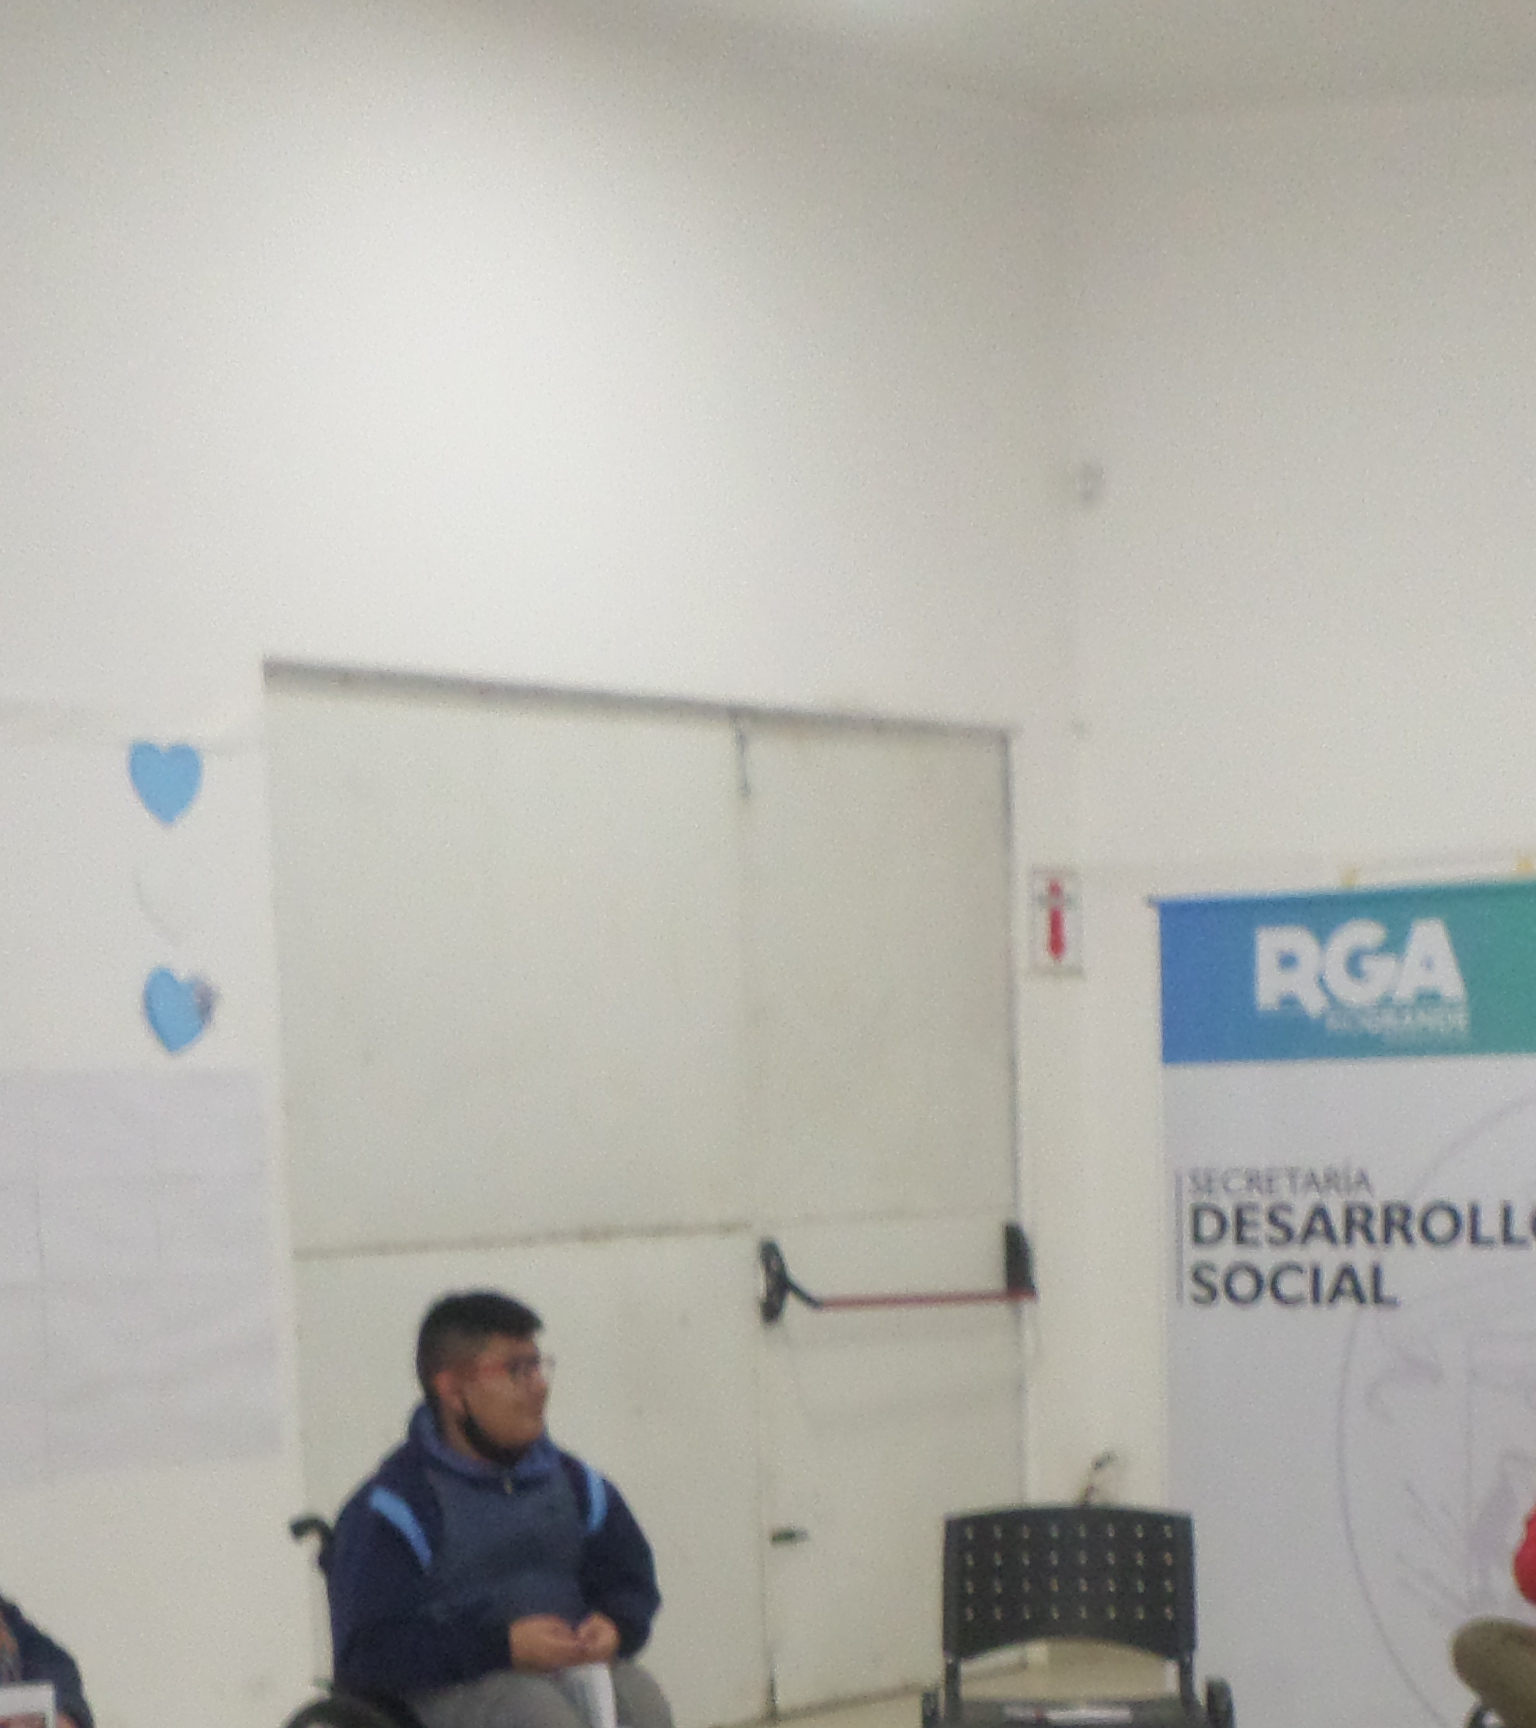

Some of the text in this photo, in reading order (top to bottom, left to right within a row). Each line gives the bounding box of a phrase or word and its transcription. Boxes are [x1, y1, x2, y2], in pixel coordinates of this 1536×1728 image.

[1254, 917, 1466, 1018] RGA
[1188, 1157, 1374, 1198] SECRETARÍA
[1189, 1260, 1400, 1306] SOCIAL
